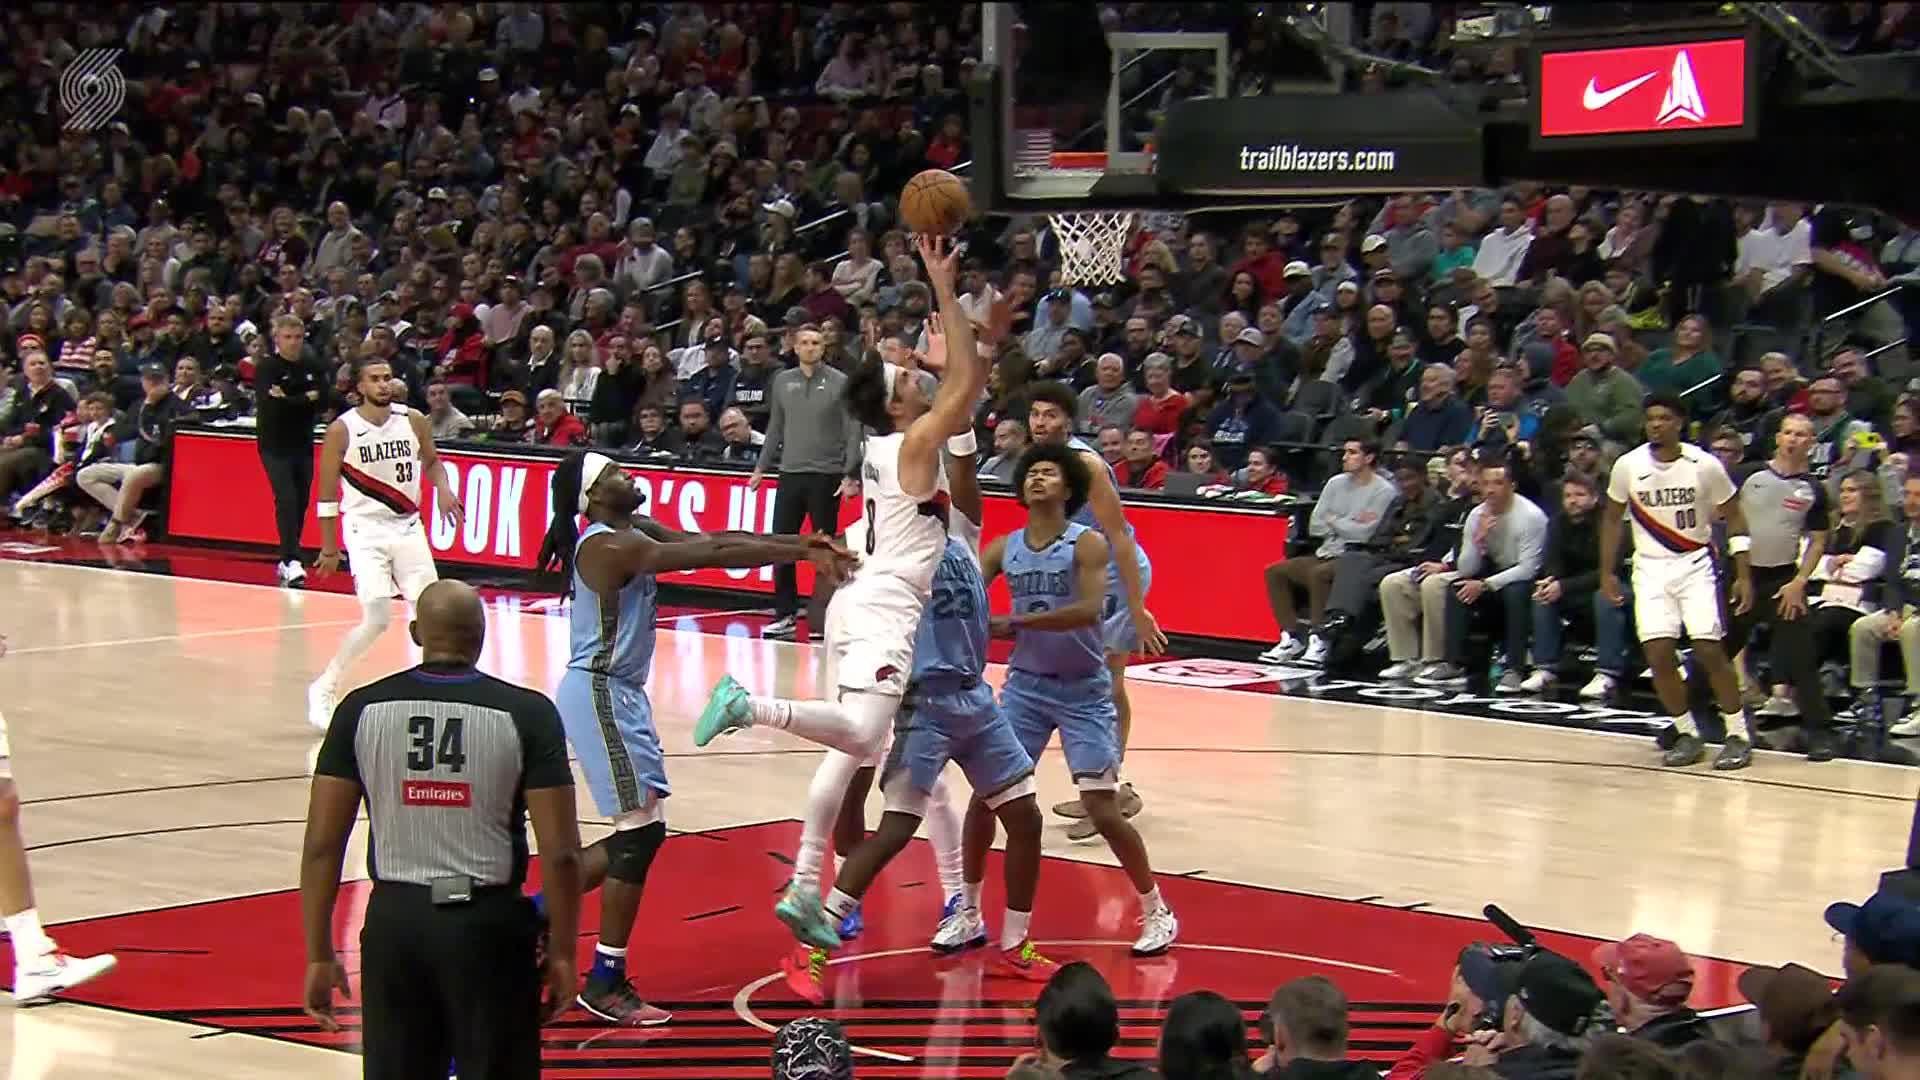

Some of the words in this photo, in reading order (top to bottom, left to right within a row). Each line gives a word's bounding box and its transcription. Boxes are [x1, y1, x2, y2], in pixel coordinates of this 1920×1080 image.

[1240, 145, 1394, 170] trailblazers.com
[359, 440, 412, 463] BLAZERS
[395, 461, 412, 483] 33
[1676, 508, 1696, 530] 00
[932, 588, 974, 618] 23
[407, 716, 466, 773] 34
[407, 786, 465, 801] Emirates
